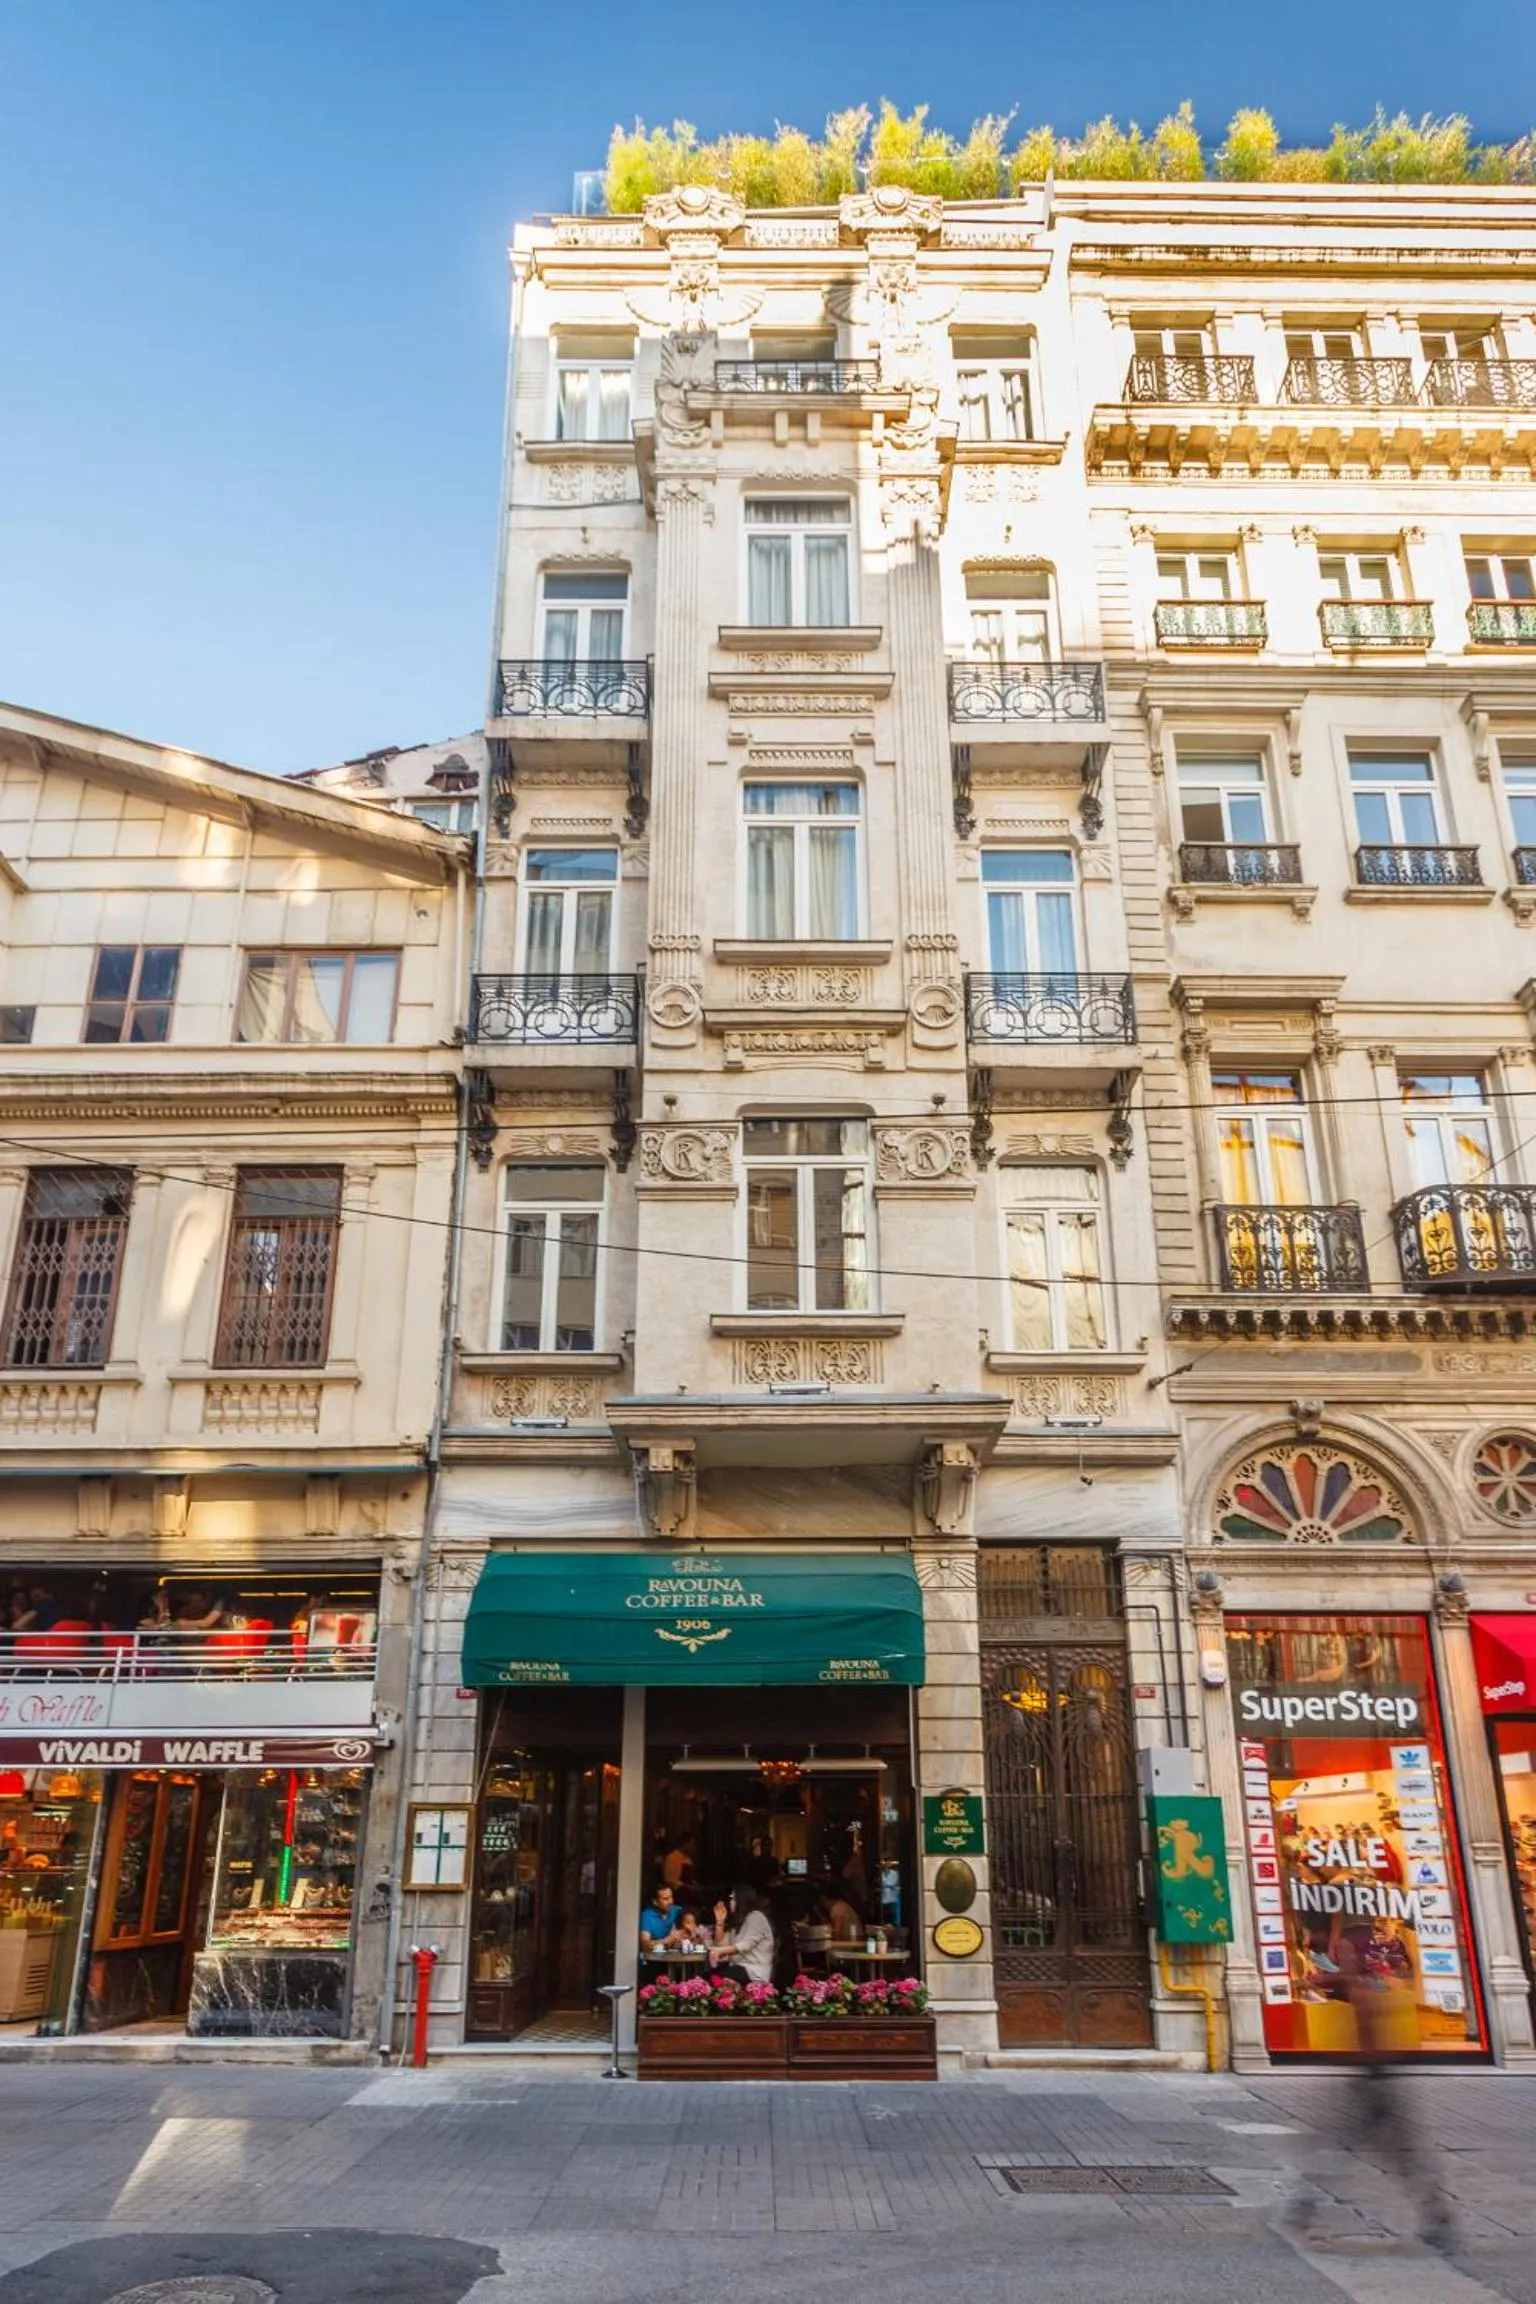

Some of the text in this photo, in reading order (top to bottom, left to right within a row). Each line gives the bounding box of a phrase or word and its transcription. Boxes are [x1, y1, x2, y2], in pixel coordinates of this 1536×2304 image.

[648, 1577, 744, 1592] RAVOUNA
[675, 1619, 711, 1631] 1906
[1239, 1690, 1418, 1728] SuperStep
[163, 1741, 265, 1762] WAFFLE
[1307, 1838, 1389, 1868] SALE
[1417, 1922, 1452, 1935] POLO
